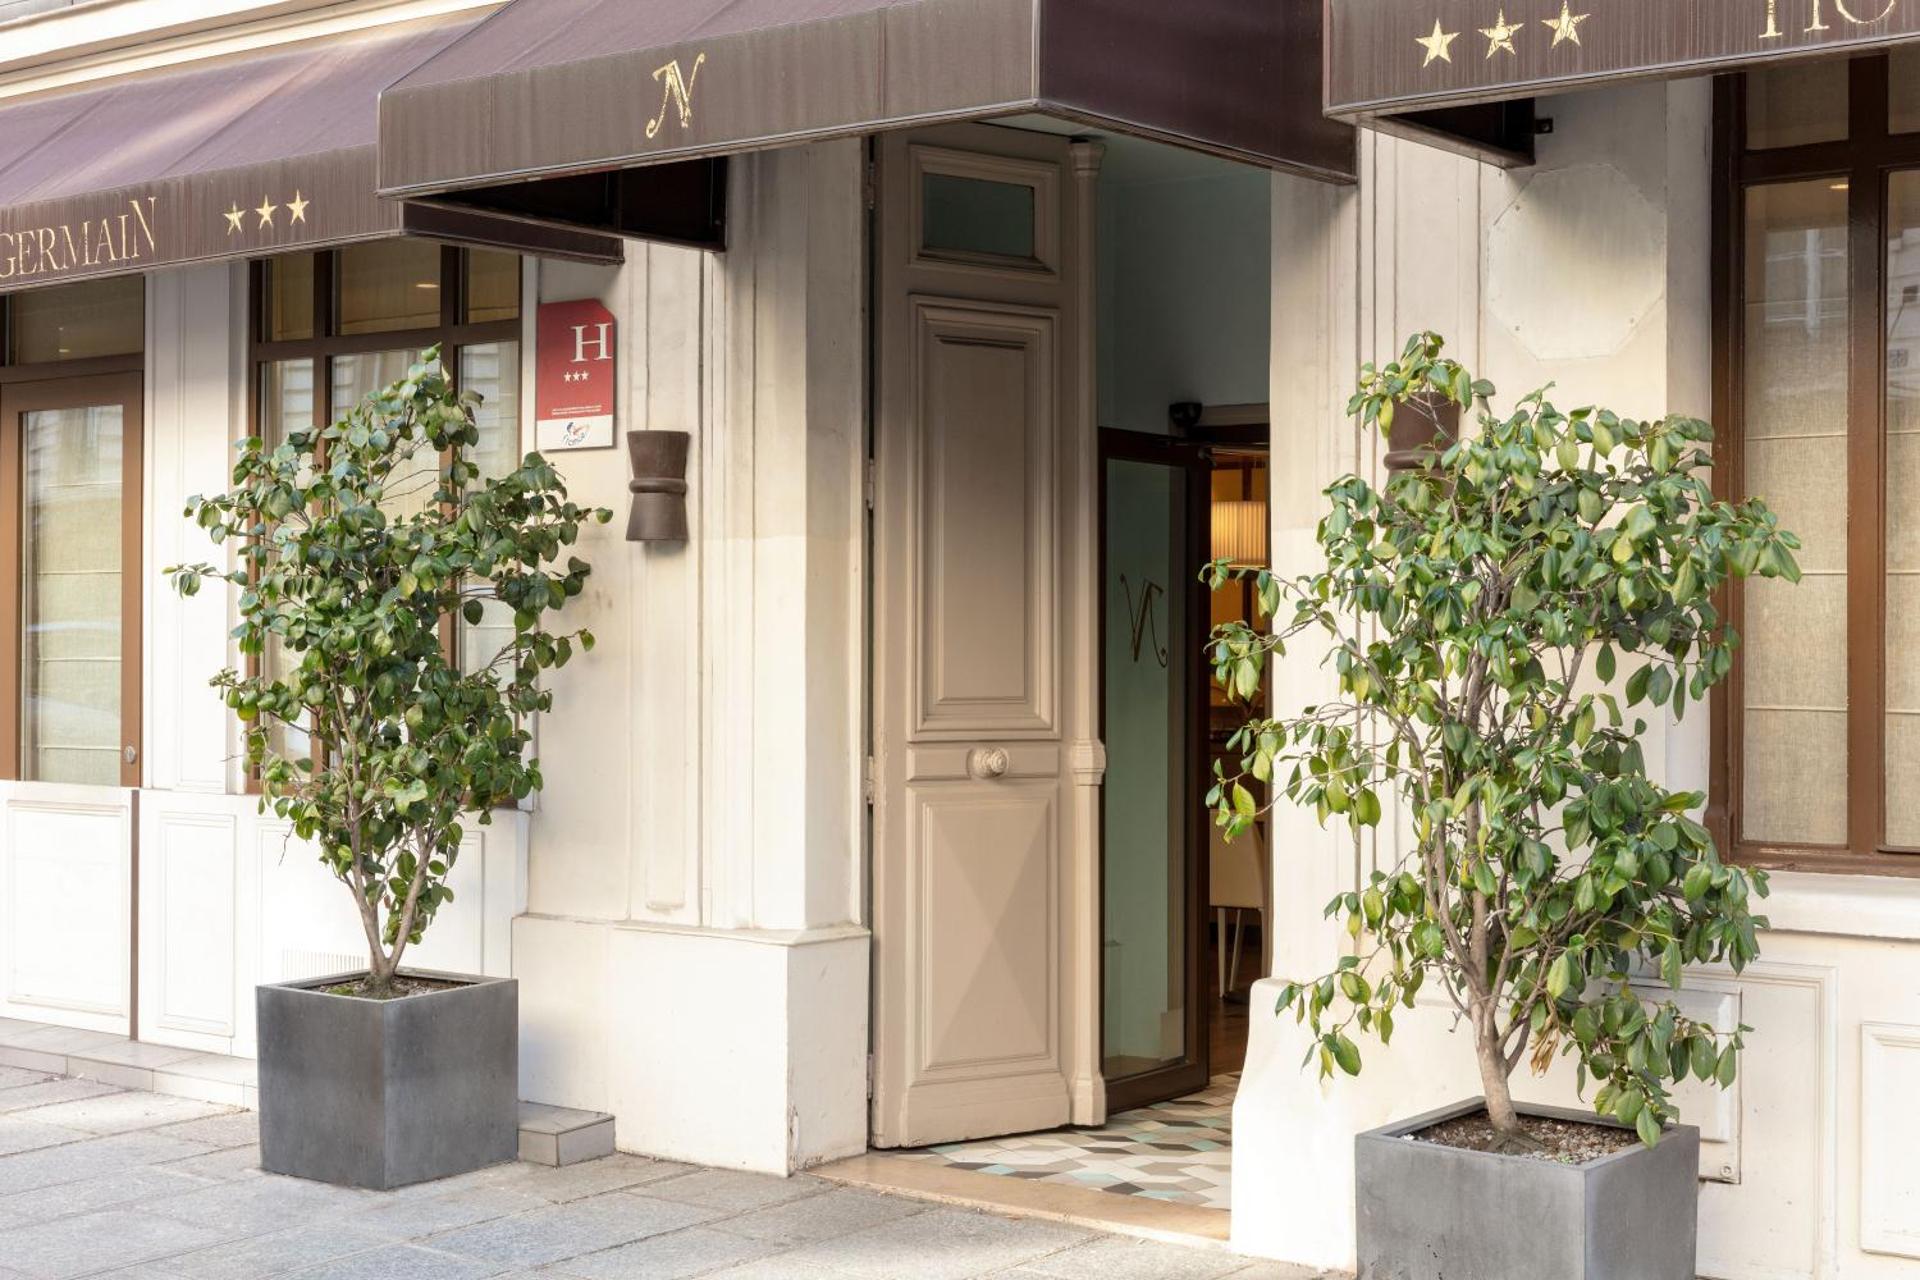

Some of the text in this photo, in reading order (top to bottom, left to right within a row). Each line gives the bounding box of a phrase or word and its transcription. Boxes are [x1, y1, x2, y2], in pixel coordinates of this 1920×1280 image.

[646, 53, 705, 138] N
[0, 197, 157, 278] GERMAIN
[570, 322, 614, 363] H
